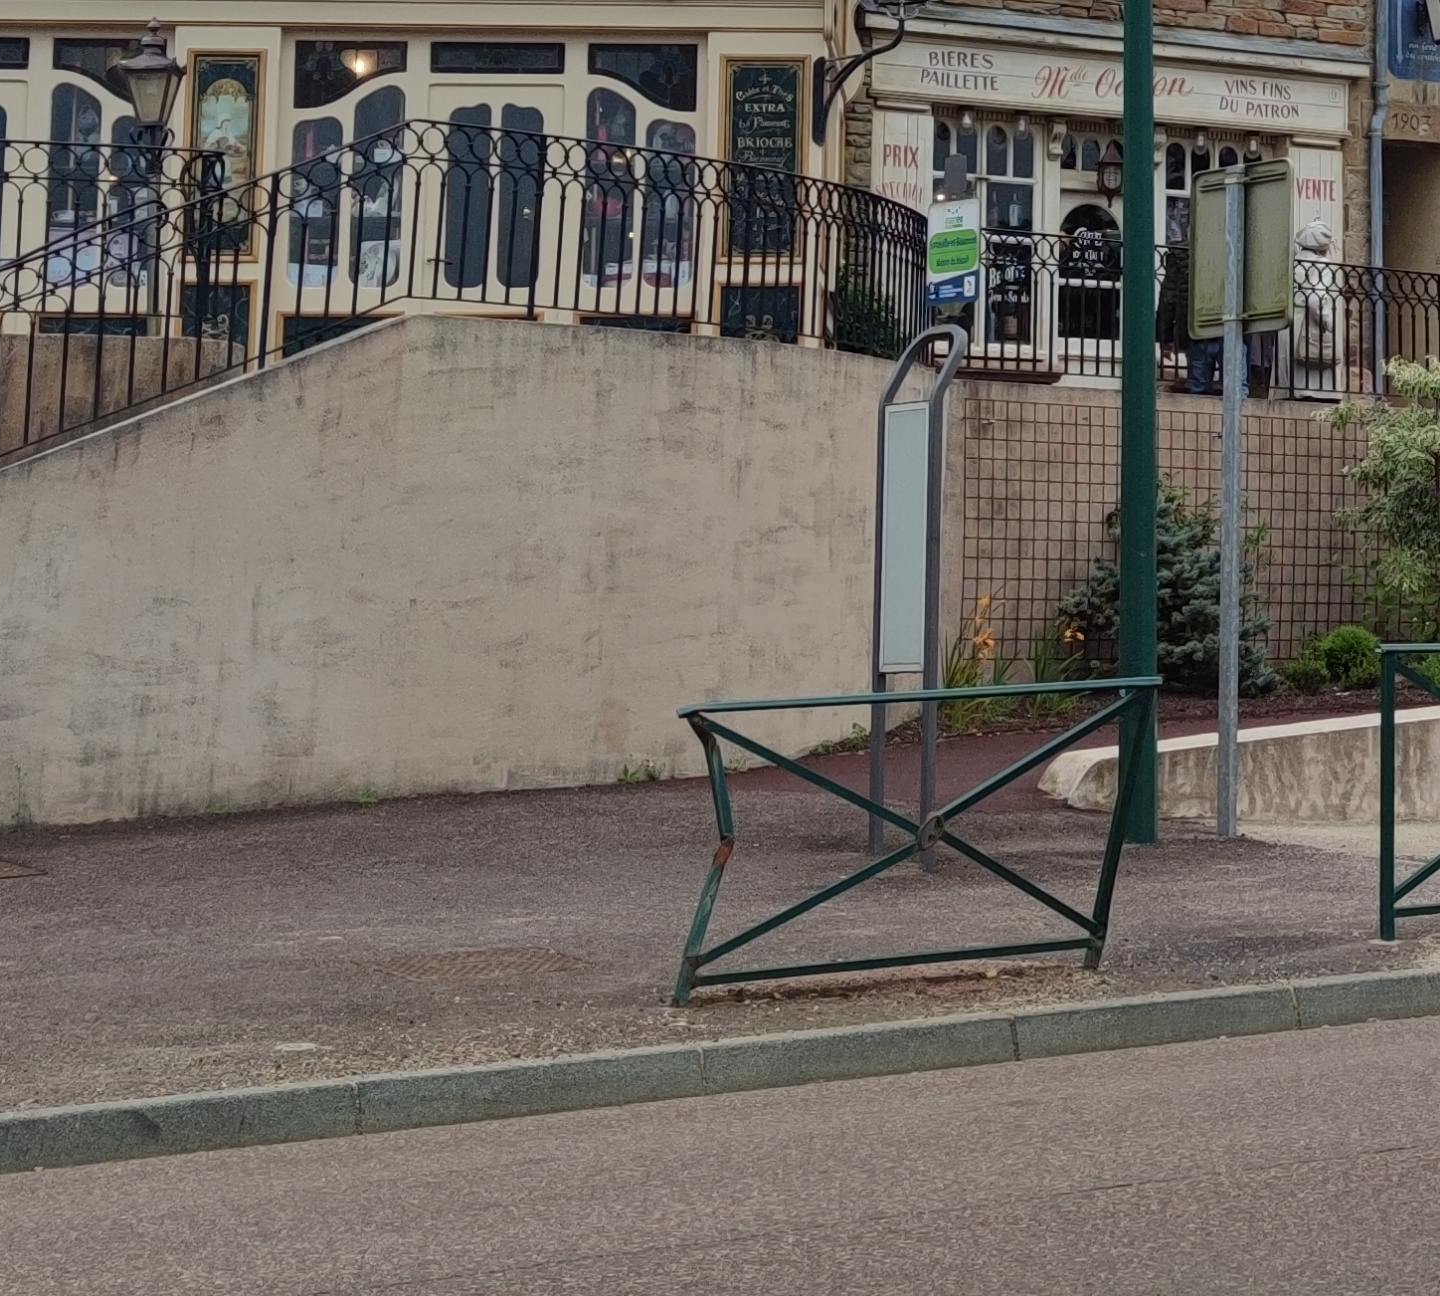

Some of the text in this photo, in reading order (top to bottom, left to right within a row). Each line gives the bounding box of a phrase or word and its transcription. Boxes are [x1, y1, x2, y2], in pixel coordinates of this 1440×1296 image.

[920, 69, 1000, 91] PAILLETTE
[1224, 79, 1292, 101] VINS FINS
[745, 103, 786, 113] EXTRA
[1219, 96, 1300, 119] DU PATRON
[737, 137, 793, 148] BRIOCHE
[883, 144, 919, 169] PRIX
[1296, 177, 1336, 202] VENTE
